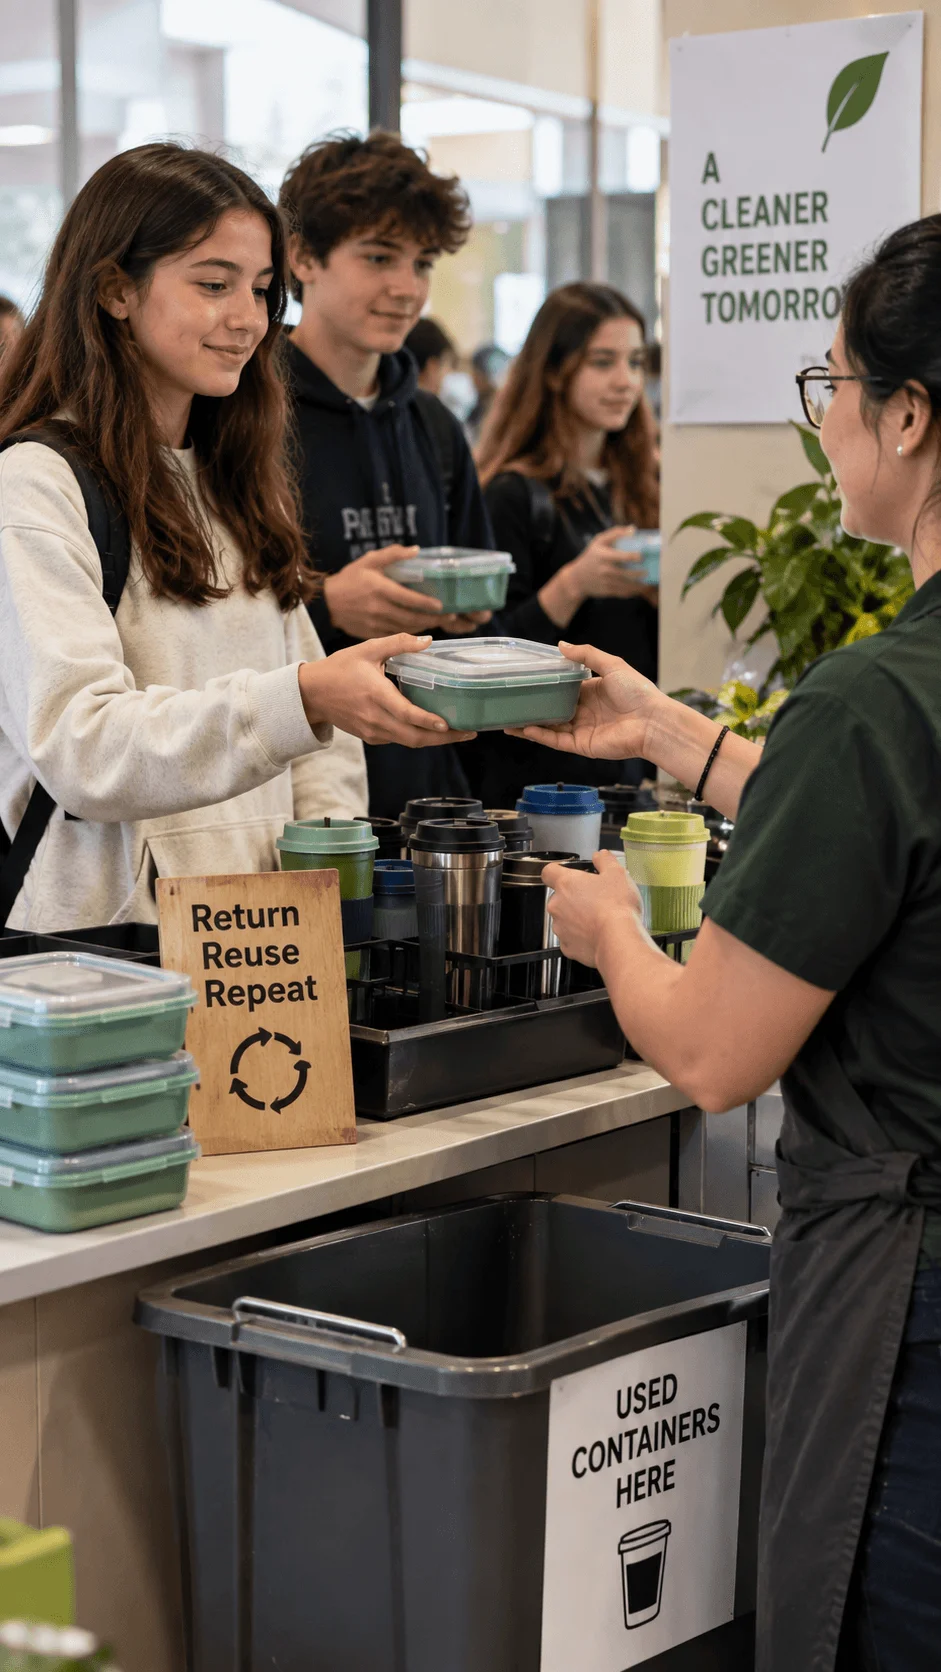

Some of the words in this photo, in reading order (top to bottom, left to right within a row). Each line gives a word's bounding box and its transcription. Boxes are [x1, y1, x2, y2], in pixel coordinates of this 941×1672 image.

[701, 151, 721, 185] A
[701, 190, 828, 231] CLEANER
[701, 239, 828, 277] GREENER
[701, 286, 842, 324] TOMORRO
[191, 904, 300, 933] Return
[202, 941, 300, 970] Reuse
[204, 975, 318, 1012] Repeat
[616, 1373, 678, 1420] USED
[571, 1402, 721, 1479] CONTAINERS
[616, 1459, 676, 1508] HERE
